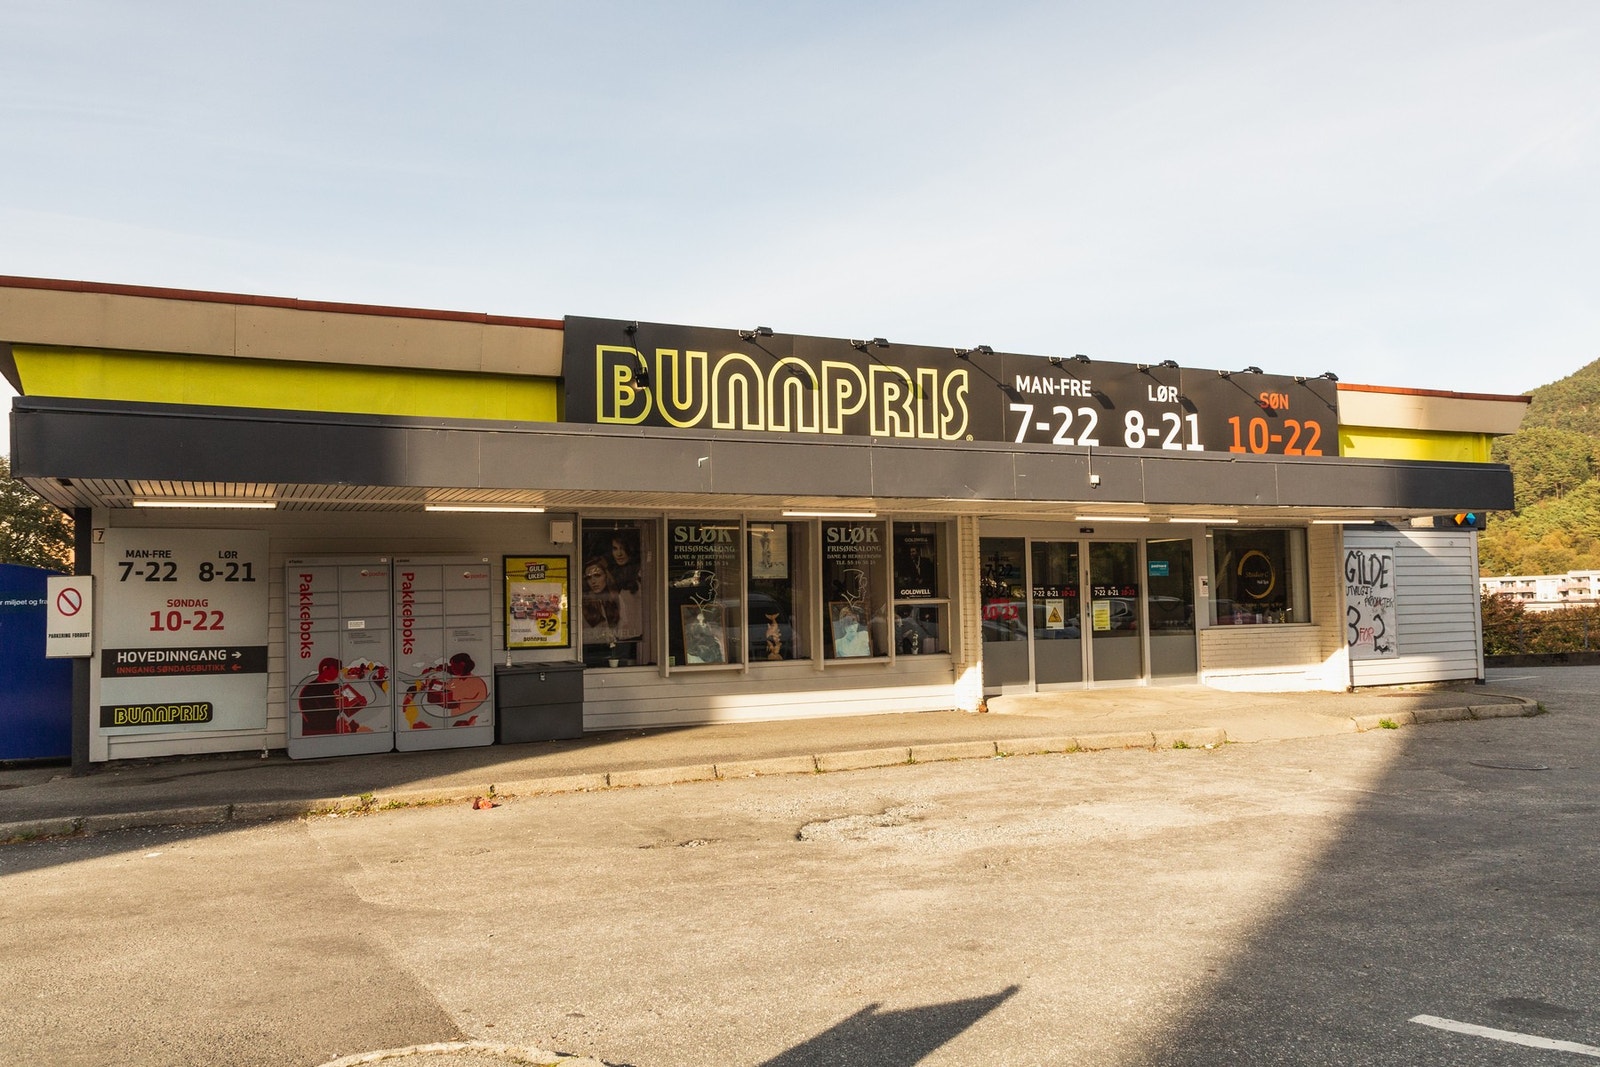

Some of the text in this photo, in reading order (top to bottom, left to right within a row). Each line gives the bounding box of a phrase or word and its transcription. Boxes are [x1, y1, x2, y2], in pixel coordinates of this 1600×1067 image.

[596, 344, 969, 441] BUNNPRIS
[1016, 375, 1092, 398] MAN-FRE
[1148, 384, 1178, 404] LØR
[1260, 391, 1289, 410] SØN
[1009, 404, 1099, 447] 7-22
[1124, 410, 1204, 452] 8-21
[1228, 416, 1322, 456] 10-22
[674, 525, 732, 544] SLØK
[827, 526, 878, 544] SLØK
[126, 550, 238, 560] MAN-FRE LØR
[118, 562, 256, 582] 7-22 8-21
[529, 564, 545, 572] GULE
[4, 598, 27, 606] miljøet
[166, 598, 208, 608] SØNDAG
[150, 610, 224, 632] 10-22
[299, 573, 314, 659] Pakkeboks
[402, 572, 416, 655] Pakkeboks
[983, 605, 1018, 620] 10-22
[539, 620, 546, 629] 3
[547, 618, 557, 632] 2
[1347, 605, 1388, 653] 3 FOR 2
[118, 650, 227, 663] HOVEDINNGANG
[116, 664, 226, 674] INNGANG SØNDAGSBUTIKK
[114, 704, 208, 725] BUNNPRIS
